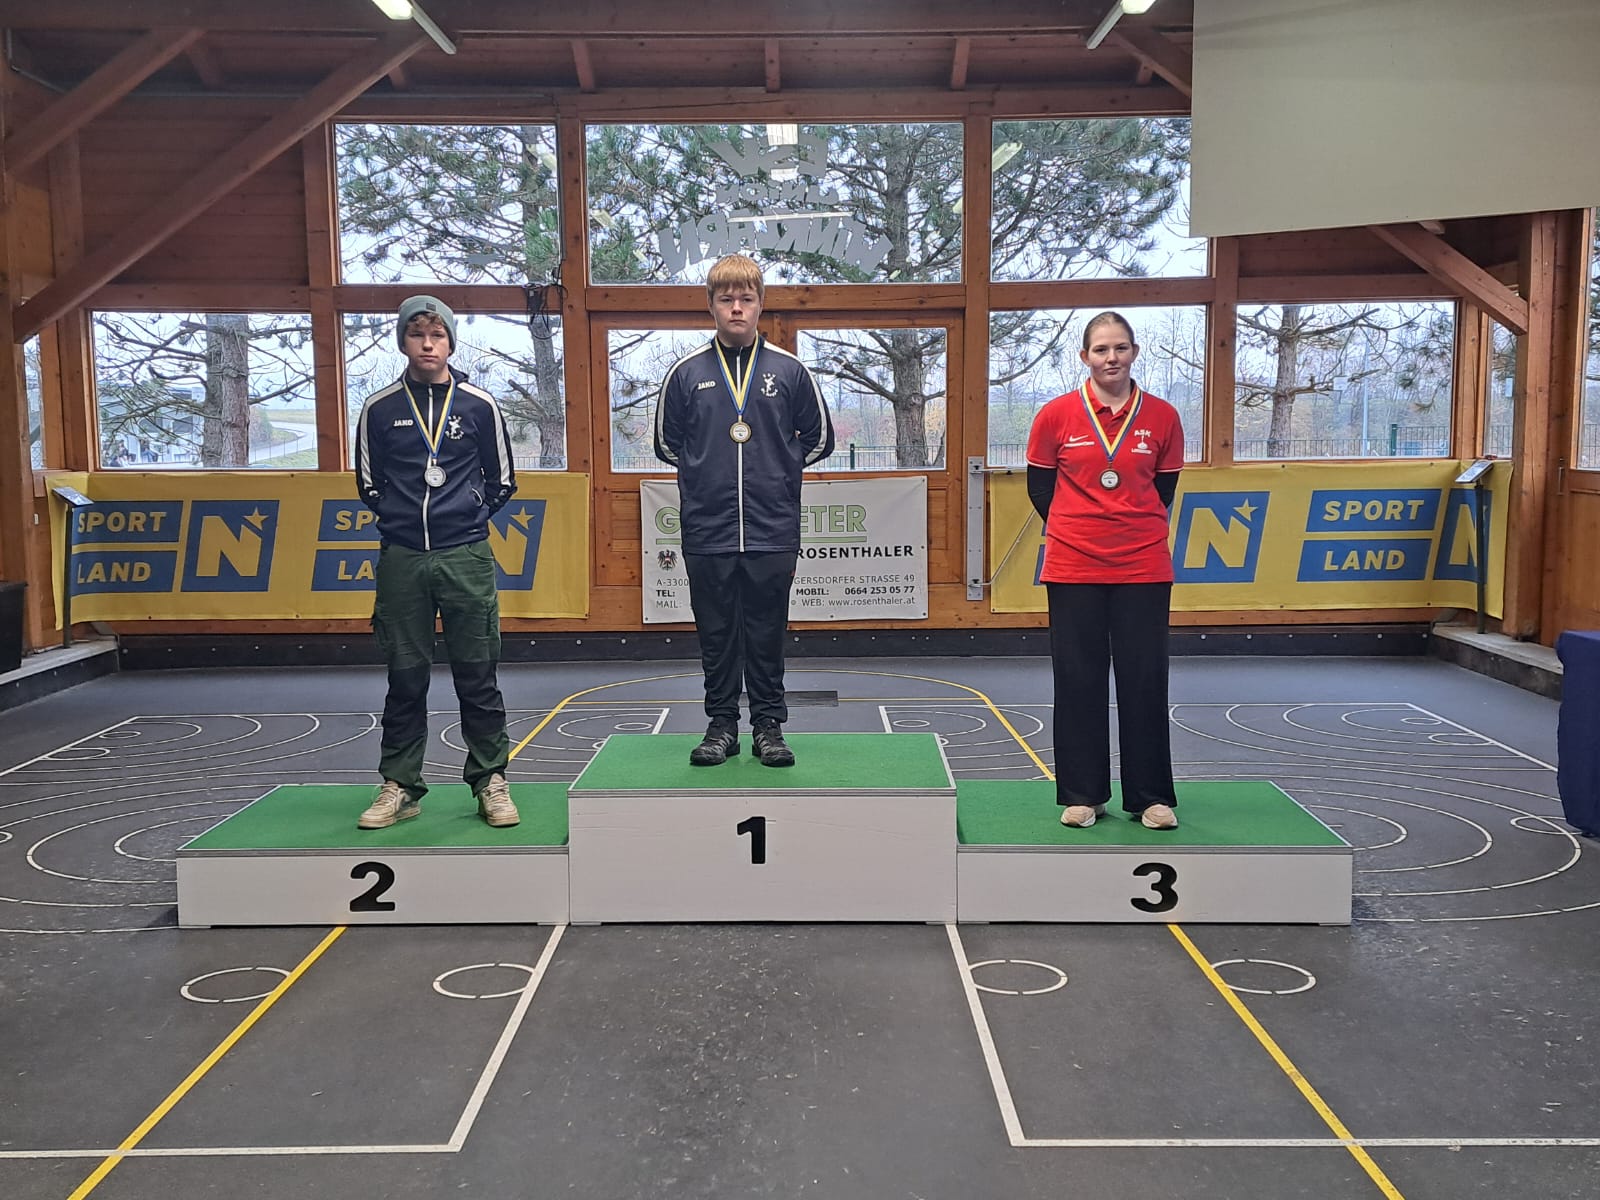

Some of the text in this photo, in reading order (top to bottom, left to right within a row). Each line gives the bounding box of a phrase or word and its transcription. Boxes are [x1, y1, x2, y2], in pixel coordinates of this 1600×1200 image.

[698, 380, 716, 390] JAKO
[393, 419, 414, 427] JAKO
[334, 510, 380, 531] SP
[1323, 500, 1425, 521] SPORT
[77, 511, 167, 533] SPORT
[797, 545, 914, 560] ROSENTHALER
[1323, 550, 1405, 571] LAND
[77, 561, 151, 584] LAND
[338, 559, 375, 580] LA
[656, 579, 689, 587] A-3300
[860, 574, 900, 584] STRASSE
[903, 574, 915, 582] 49
[656, 585, 915, 598] TEL: MOBIL: 0664 253 05 77
[656, 596, 916, 609] MAIL: WEB: www.rosenthaler.at
[737, 816, 766, 864] 1
[350, 861, 396, 912] 2
[1130, 862, 1179, 913] 3
